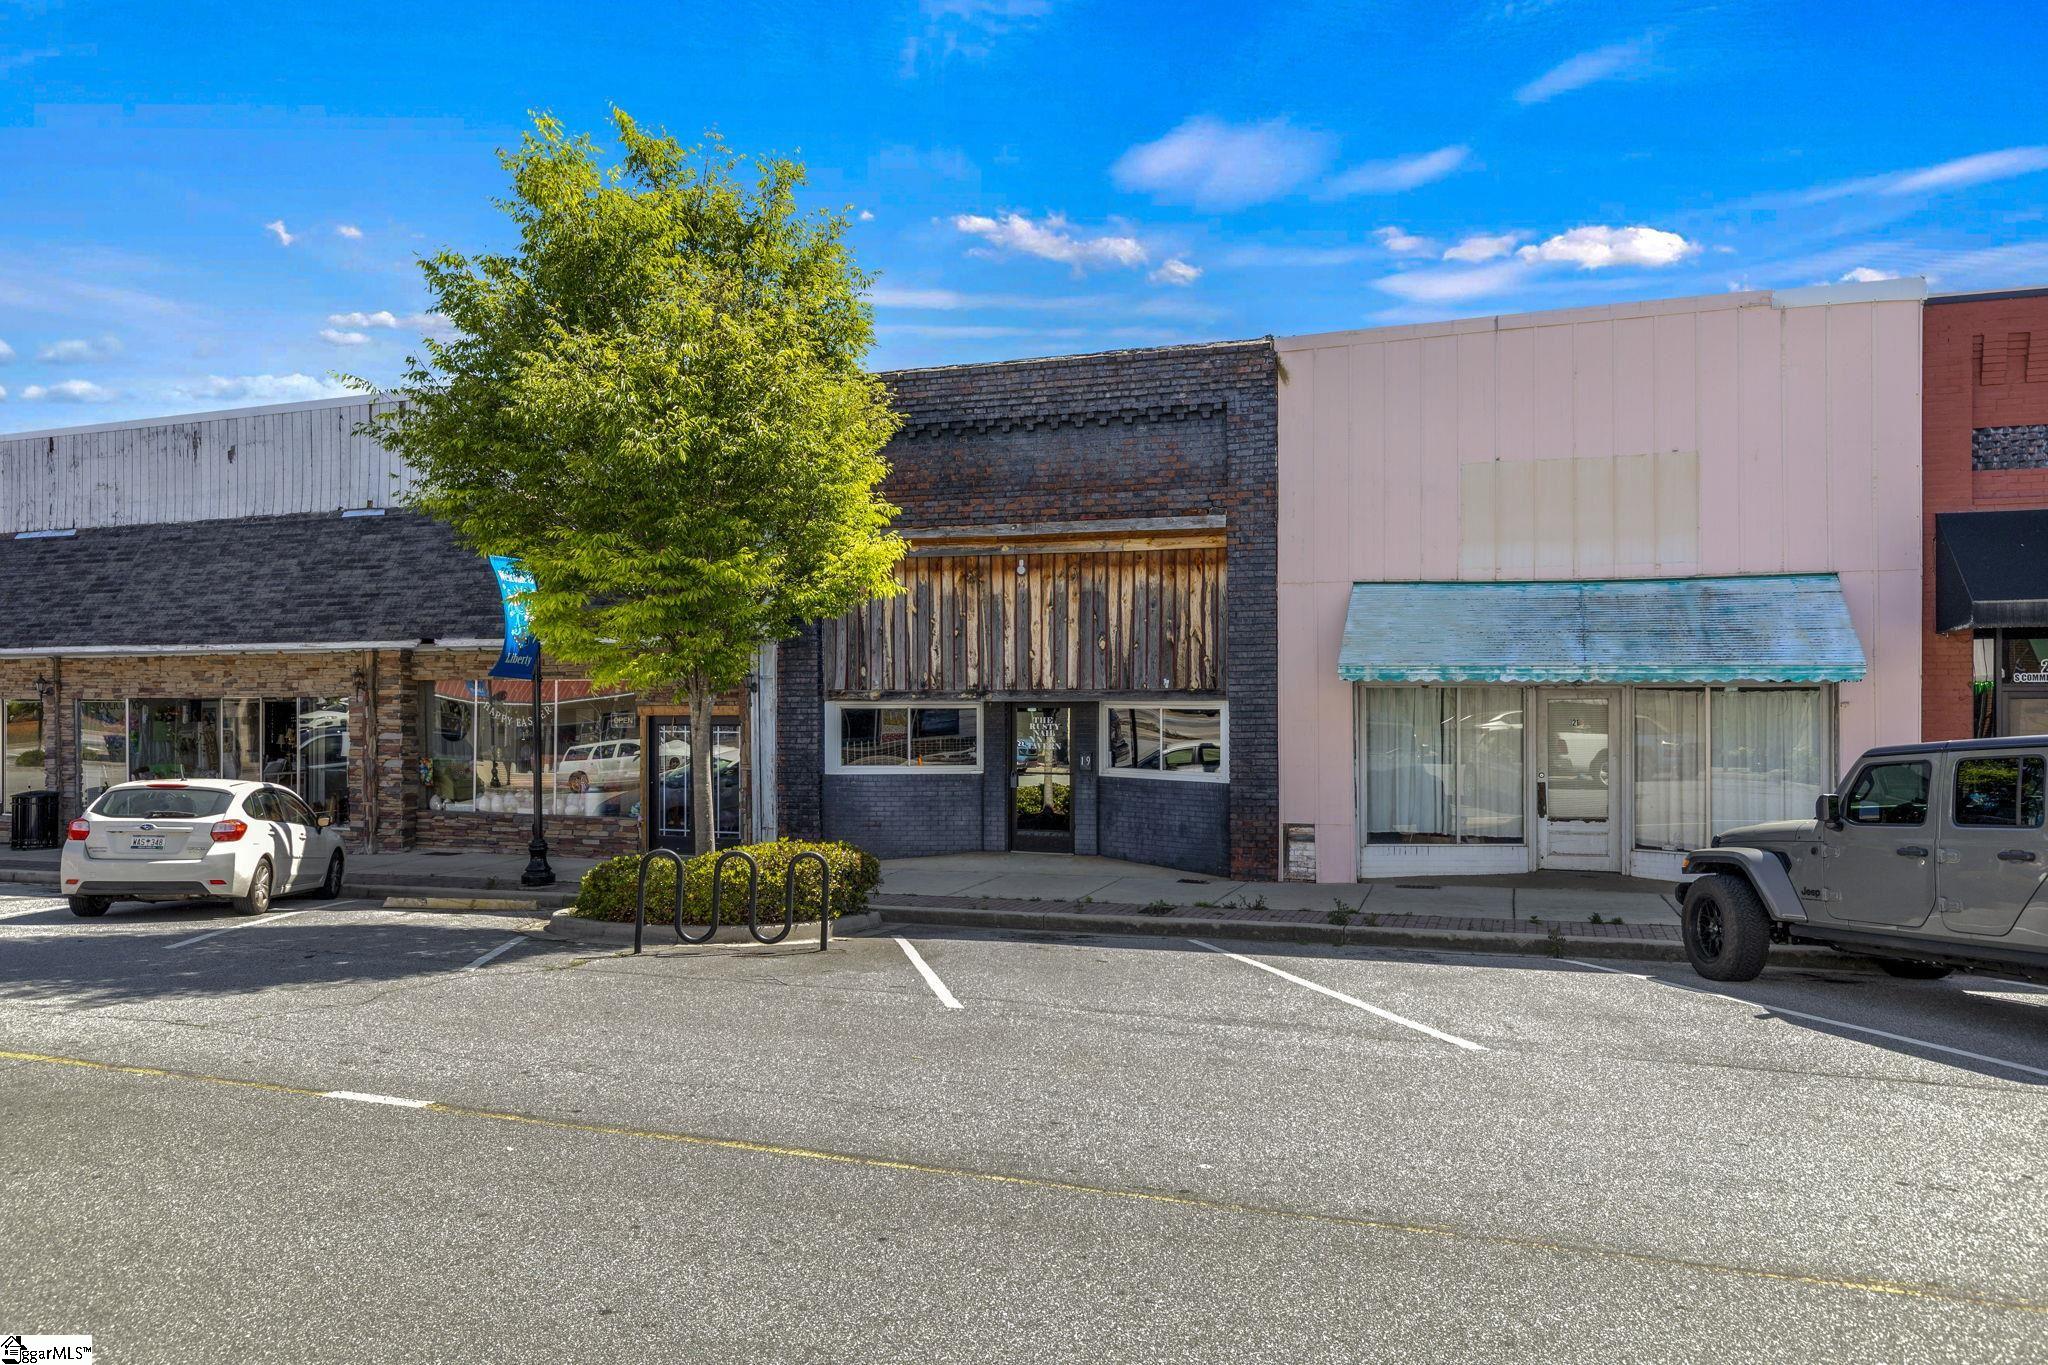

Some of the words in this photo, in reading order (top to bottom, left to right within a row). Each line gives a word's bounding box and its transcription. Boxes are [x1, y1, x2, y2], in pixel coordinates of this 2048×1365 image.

[505, 652, 532, 666] Liberty
[2021, 672, 2048, 682] COMM
[483, 701, 513, 726] HAPPY
[516, 705, 553, 727] EASER
[613, 716, 634, 725] OPEN
[1033, 716, 1054, 724] THE
[1029, 723, 1060, 731] RUSTY
[1027, 742, 1062, 750] TAVERN
[1080, 756, 1091, 766] 19
[1801, 886, 1821, 898] Jeep
